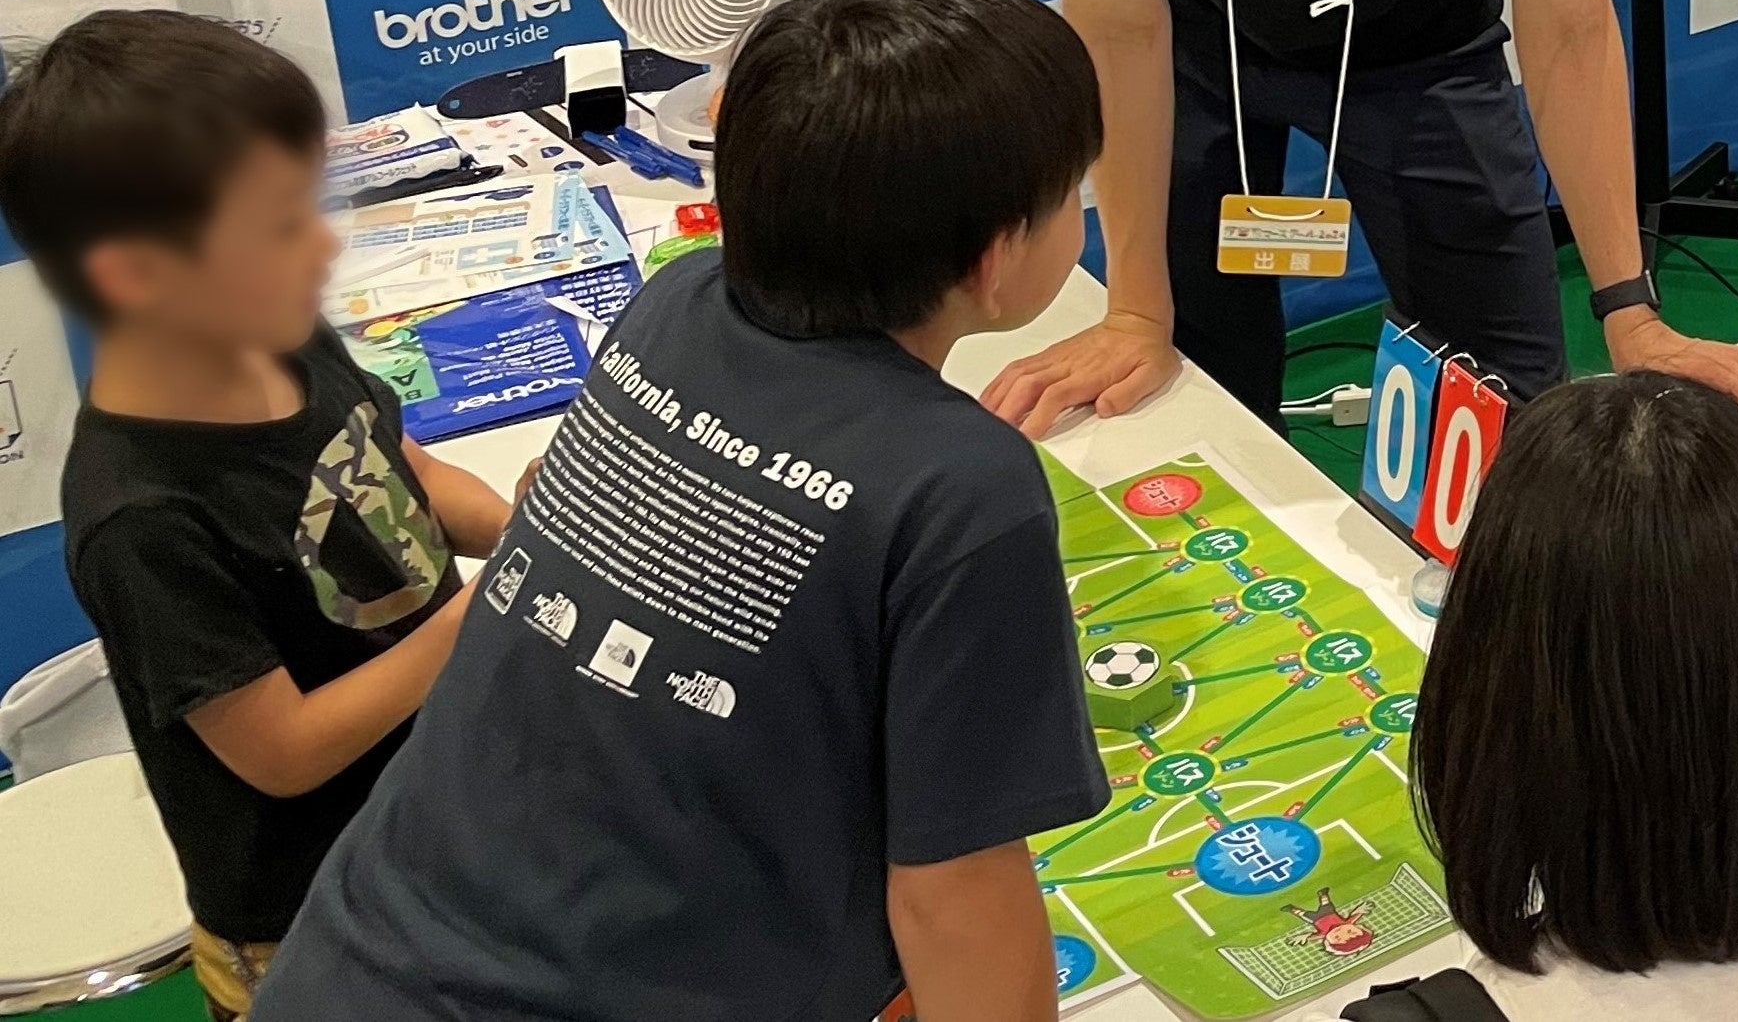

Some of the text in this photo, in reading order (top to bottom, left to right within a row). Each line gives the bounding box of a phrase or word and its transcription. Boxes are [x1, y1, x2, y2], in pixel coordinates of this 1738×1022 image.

[420, 24, 548, 64] at your side
[686, 412, 760, 467] Since
[761, 452, 854, 510] 1966
[1376, 364, 1483, 550] 0 0
[1142, 478, 1183, 508] シュート
[1205, 531, 1239, 553] パス
[1262, 582, 1297, 603] パス
[1327, 638, 1362, 663] パス
[1167, 758, 1204, 786] パス
[1215, 822, 1293, 884] シュート
